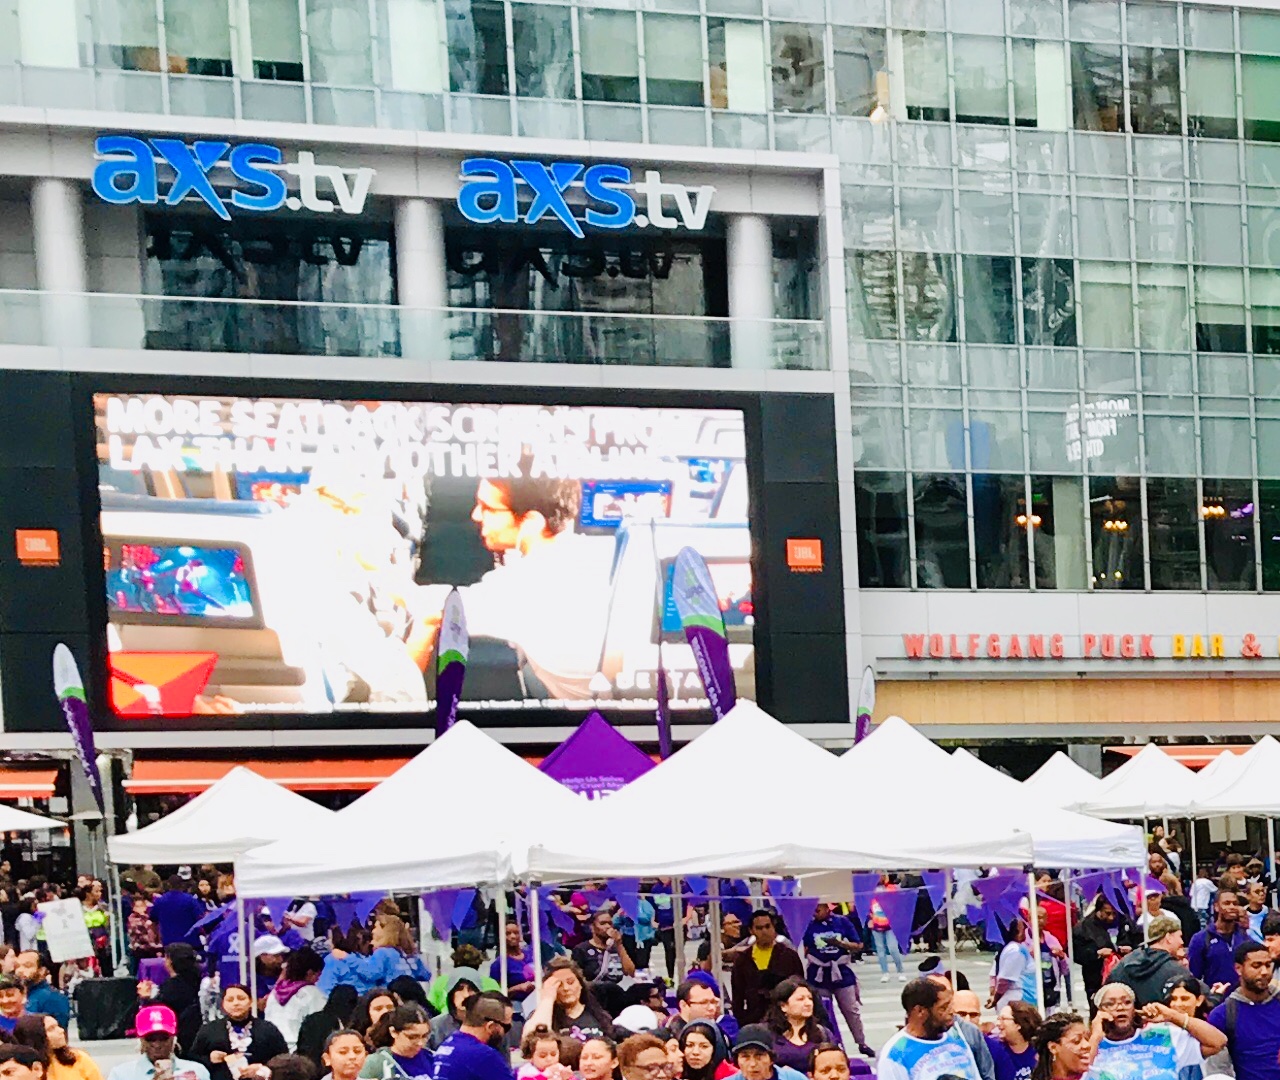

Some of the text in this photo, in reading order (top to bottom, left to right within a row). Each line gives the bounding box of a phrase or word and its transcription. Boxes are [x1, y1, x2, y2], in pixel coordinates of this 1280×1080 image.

[91, 135, 377, 221] axs.tv
[456, 158, 716, 238] axs.tv
[107, 396, 235, 437] MORE
[109, 435, 191, 472] LAX
[400, 444, 522, 479] OTHER
[902, 633, 1064, 659] WOLFGANG
[1083, 633, 1155, 659] PUCK
[1171, 633, 1226, 658] BAR
[1241, 632, 1264, 659] &
